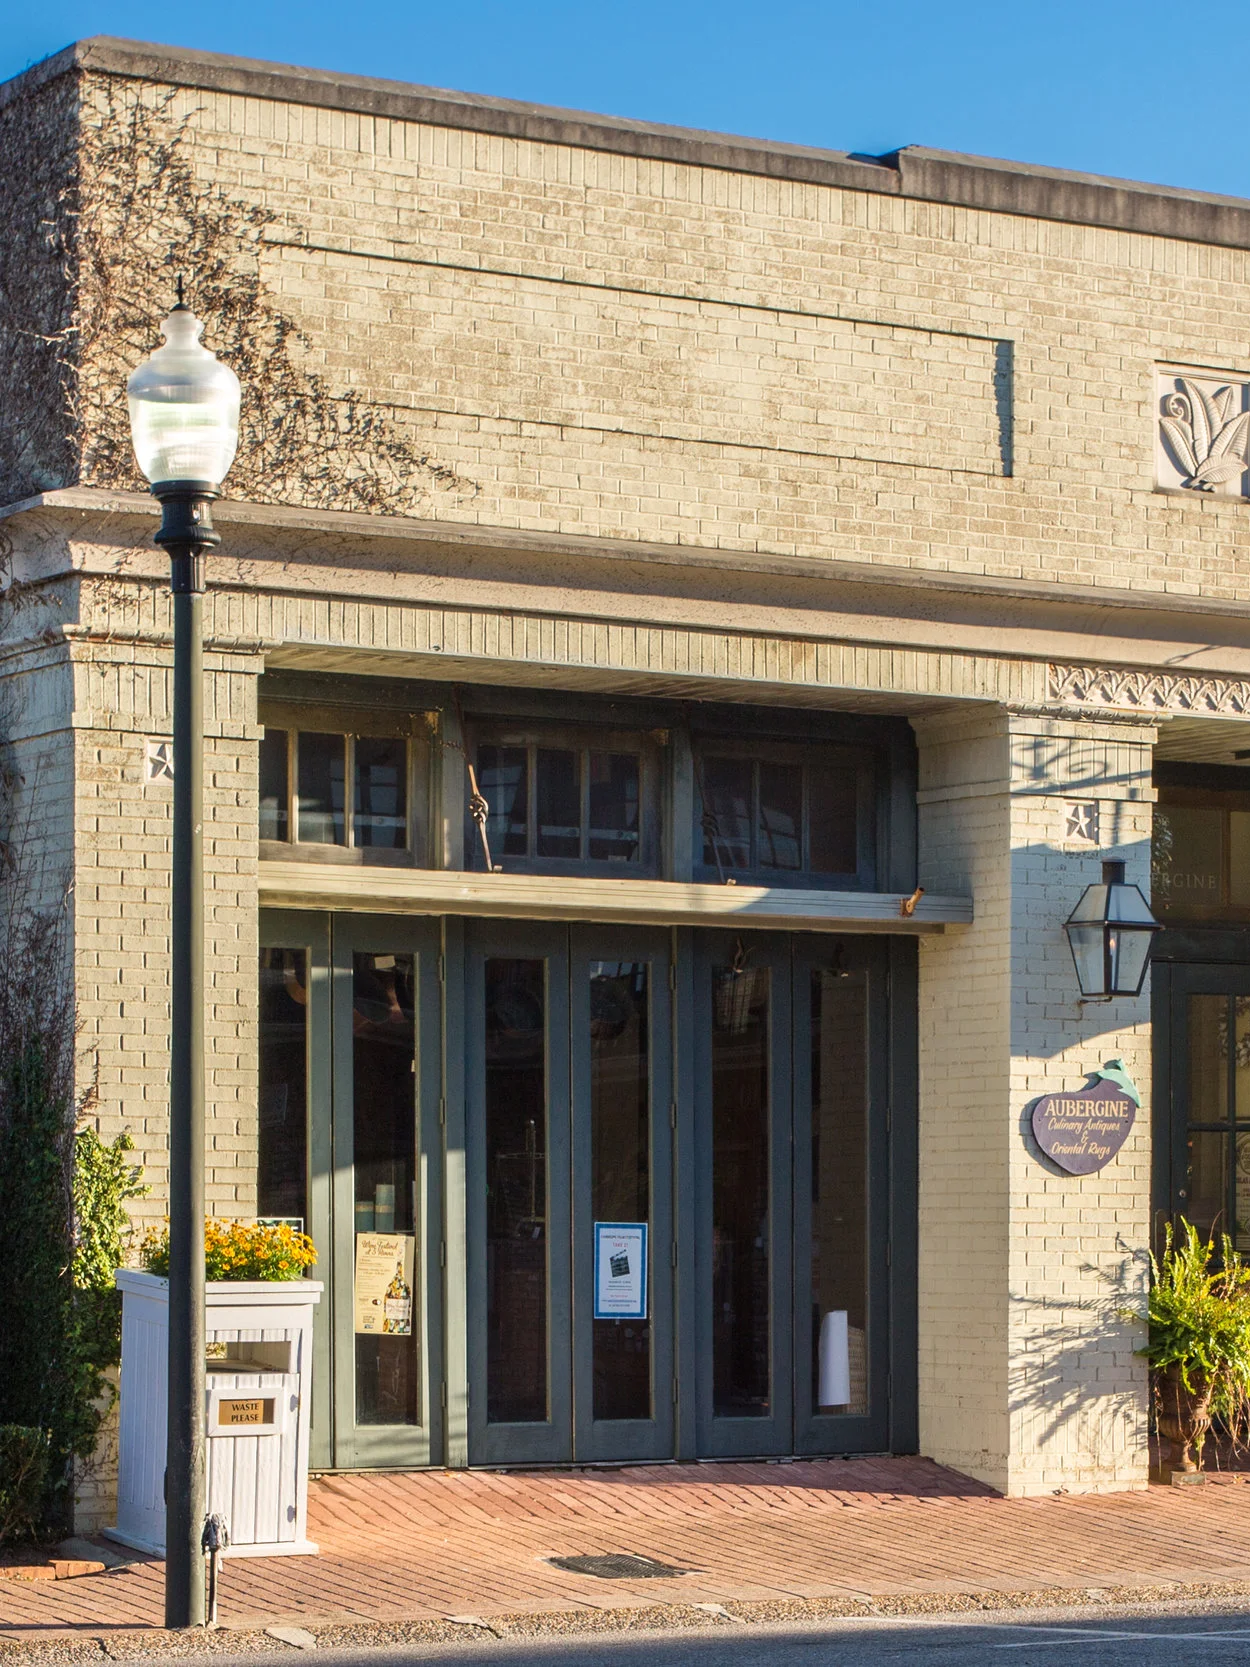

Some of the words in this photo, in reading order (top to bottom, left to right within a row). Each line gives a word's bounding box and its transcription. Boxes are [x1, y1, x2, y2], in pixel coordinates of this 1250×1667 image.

[1151, 872, 1217, 889] ERGINE
[1044, 1099, 1129, 1118] AUBERGINE
[1047, 1117, 1083, 1134] Culinary
[1082, 1118, 1120, 1136] Antiques
[1080, 1131, 1089, 1143] &
[1051, 1142, 1087, 1155] Oriental
[1088, 1142, 1110, 1160] Rugs
[232, 1403, 259, 1411] WASTE
[231, 1414, 259, 1422] PLEASE
